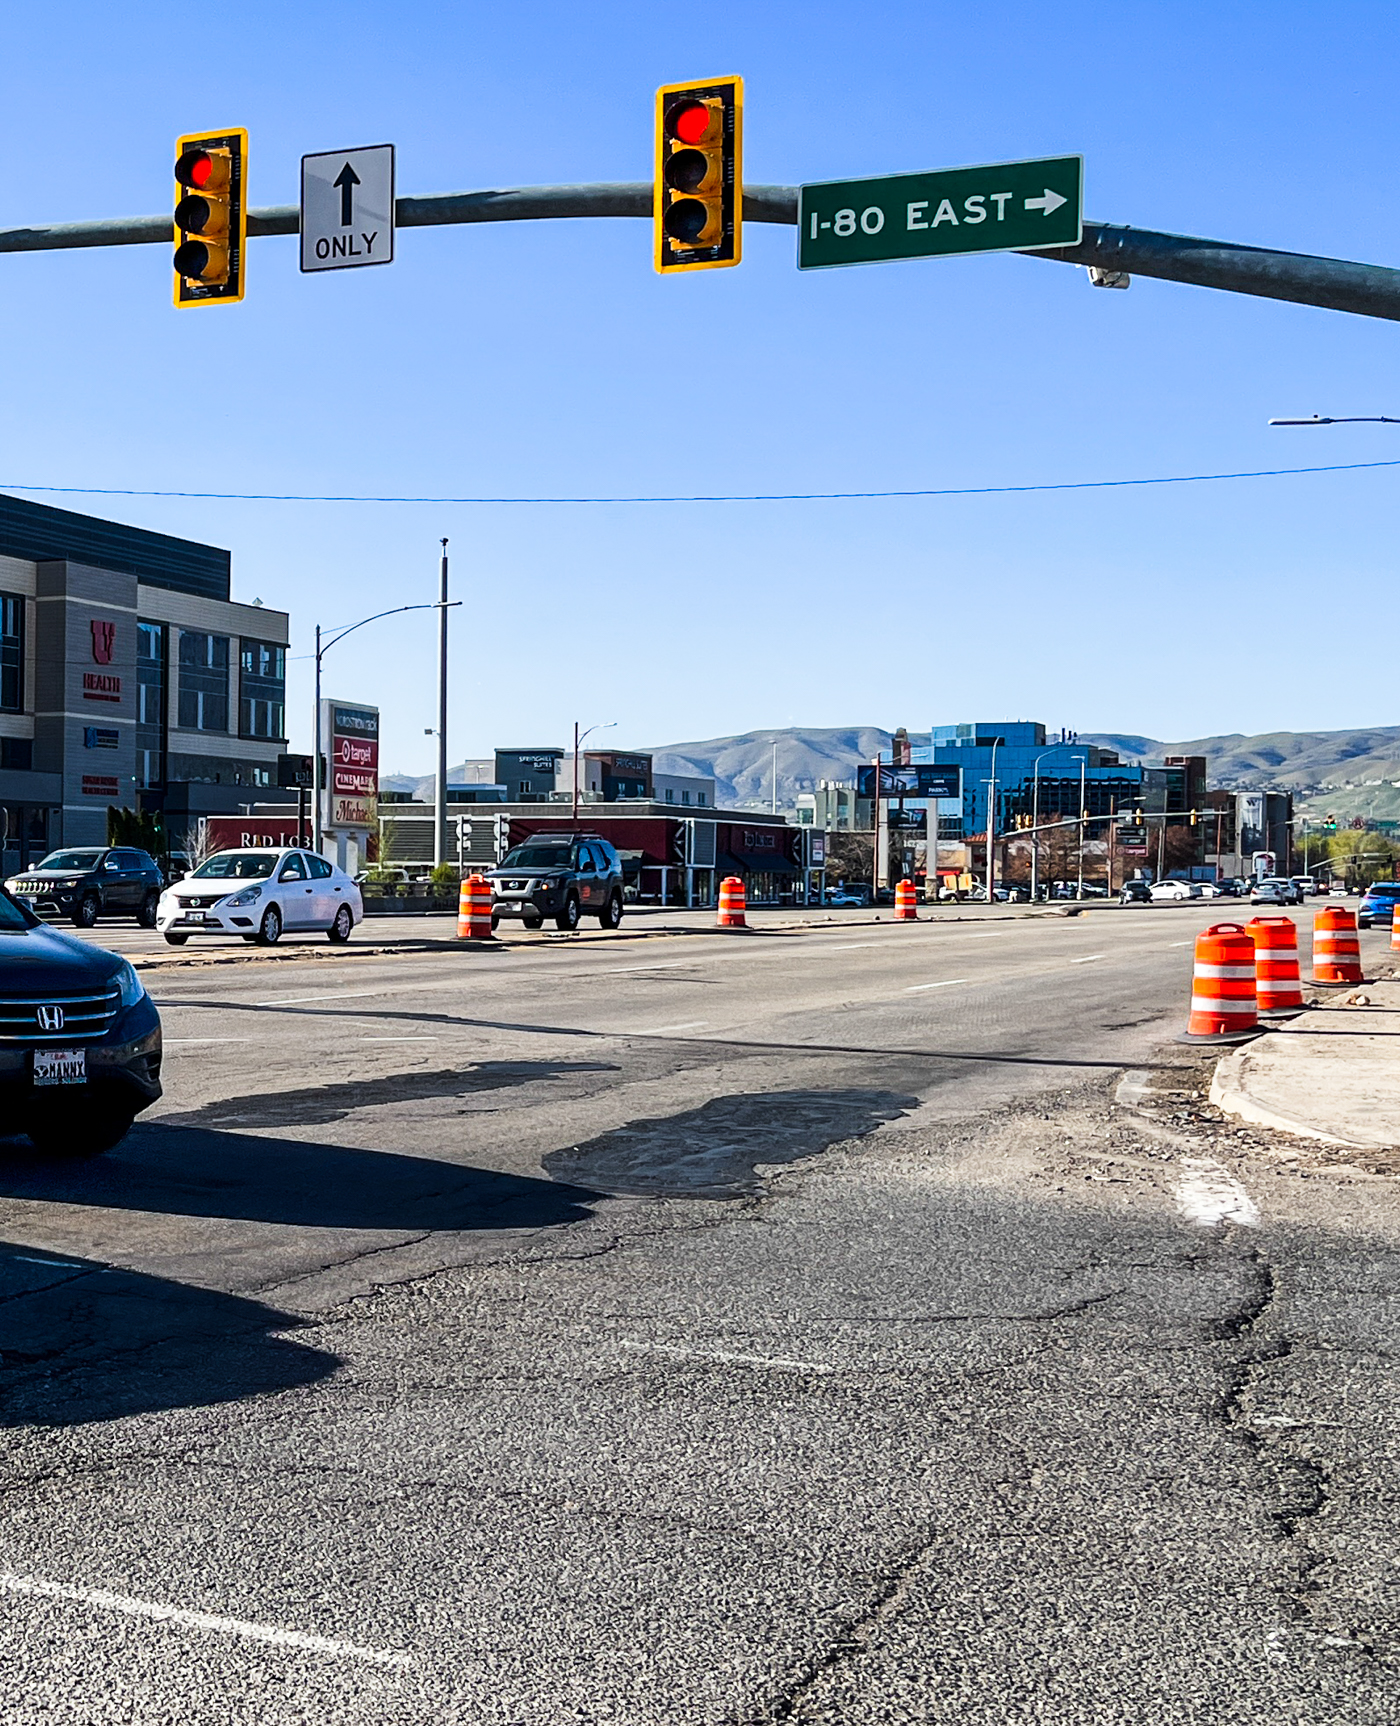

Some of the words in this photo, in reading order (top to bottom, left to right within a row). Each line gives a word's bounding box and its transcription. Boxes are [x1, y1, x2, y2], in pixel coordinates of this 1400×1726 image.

[810, 206, 885, 239] I-80
[906, 192, 1013, 230] EAST
[315, 231, 378, 259] ONLY
[83, 672, 120, 693] HEALTH
[351, 744, 371, 765] target
